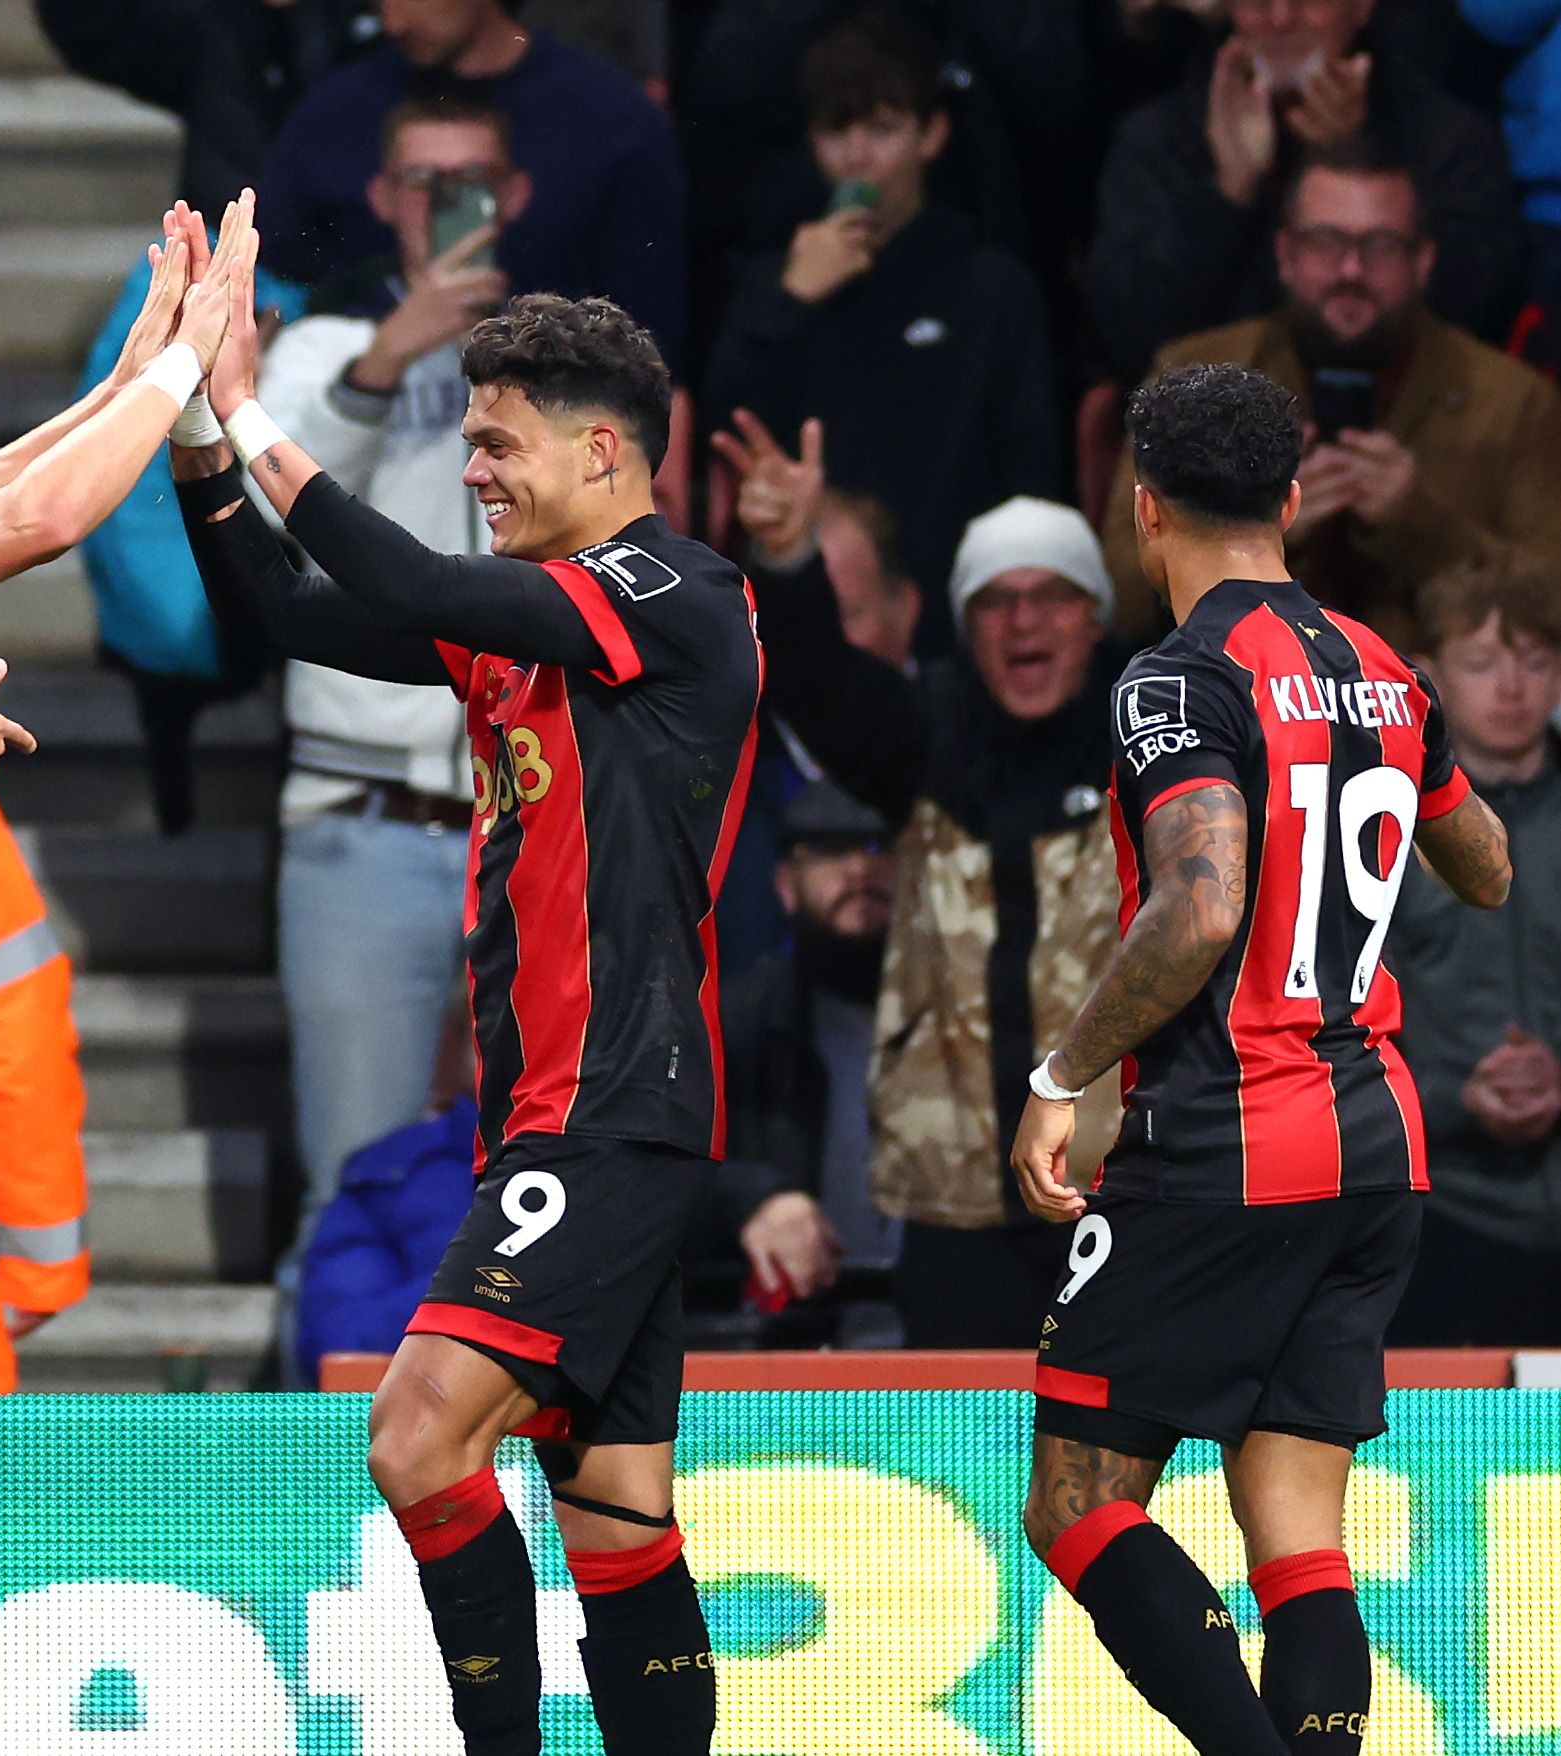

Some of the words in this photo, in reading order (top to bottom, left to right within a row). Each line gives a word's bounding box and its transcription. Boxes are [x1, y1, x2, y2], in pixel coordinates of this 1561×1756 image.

[1269, 674, 1413, 728] KLUERT
[1126, 729, 1201, 776] LEOS
[1284, 763, 1419, 1004] 19
[493, 1170, 567, 1258] 9
[1056, 1213, 1113, 1305] 9
